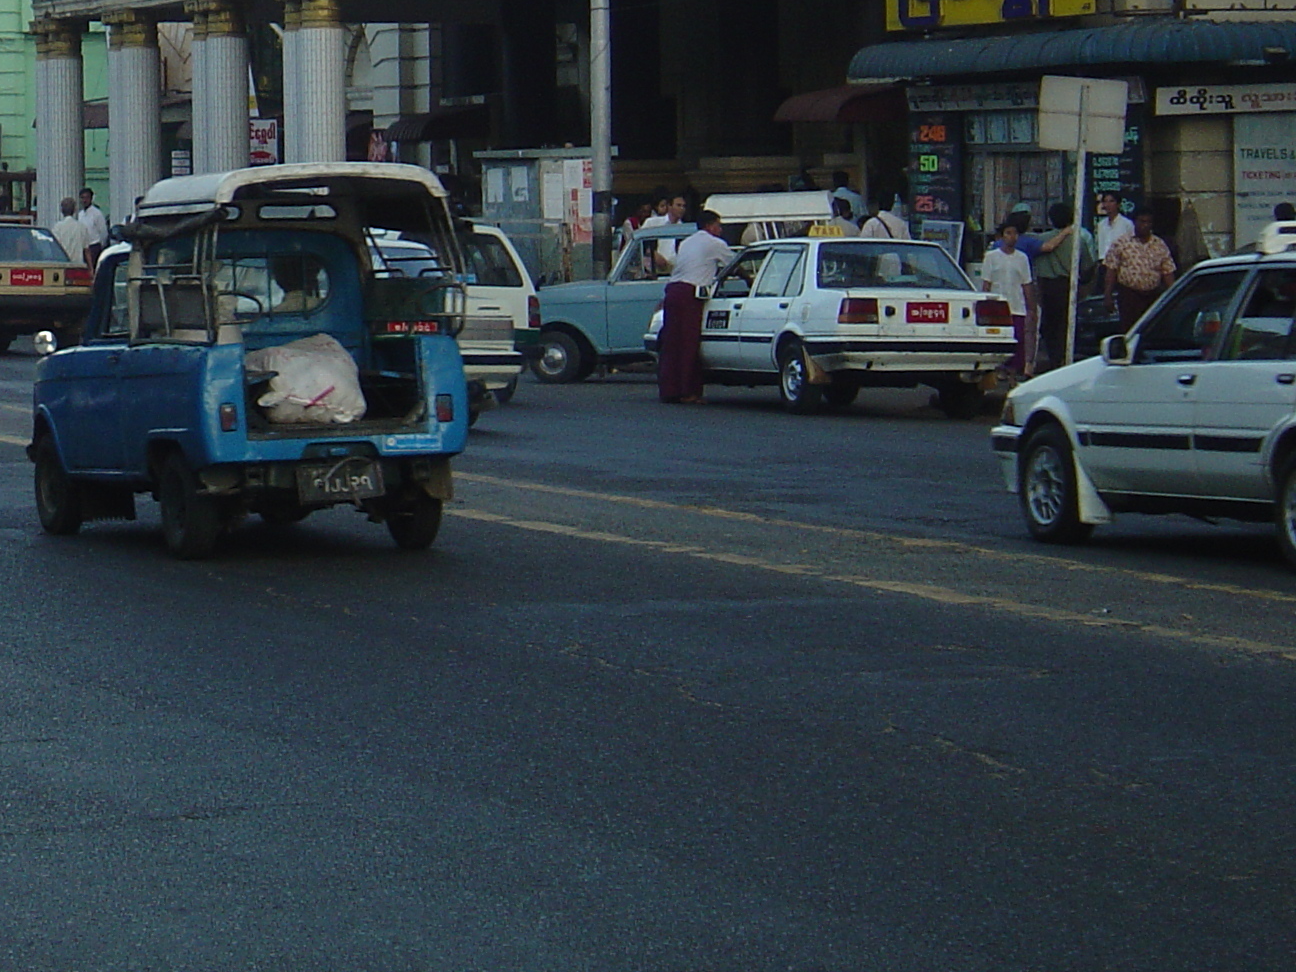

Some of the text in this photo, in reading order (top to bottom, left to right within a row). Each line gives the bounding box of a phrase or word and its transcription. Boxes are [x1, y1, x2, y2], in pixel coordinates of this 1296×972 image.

[1240, 148, 1288, 160] TRAVELS
[919, 154, 938, 172] 50
[1242, 170, 1282, 180] TICKETING
[814, 226, 841, 236] TAXI
